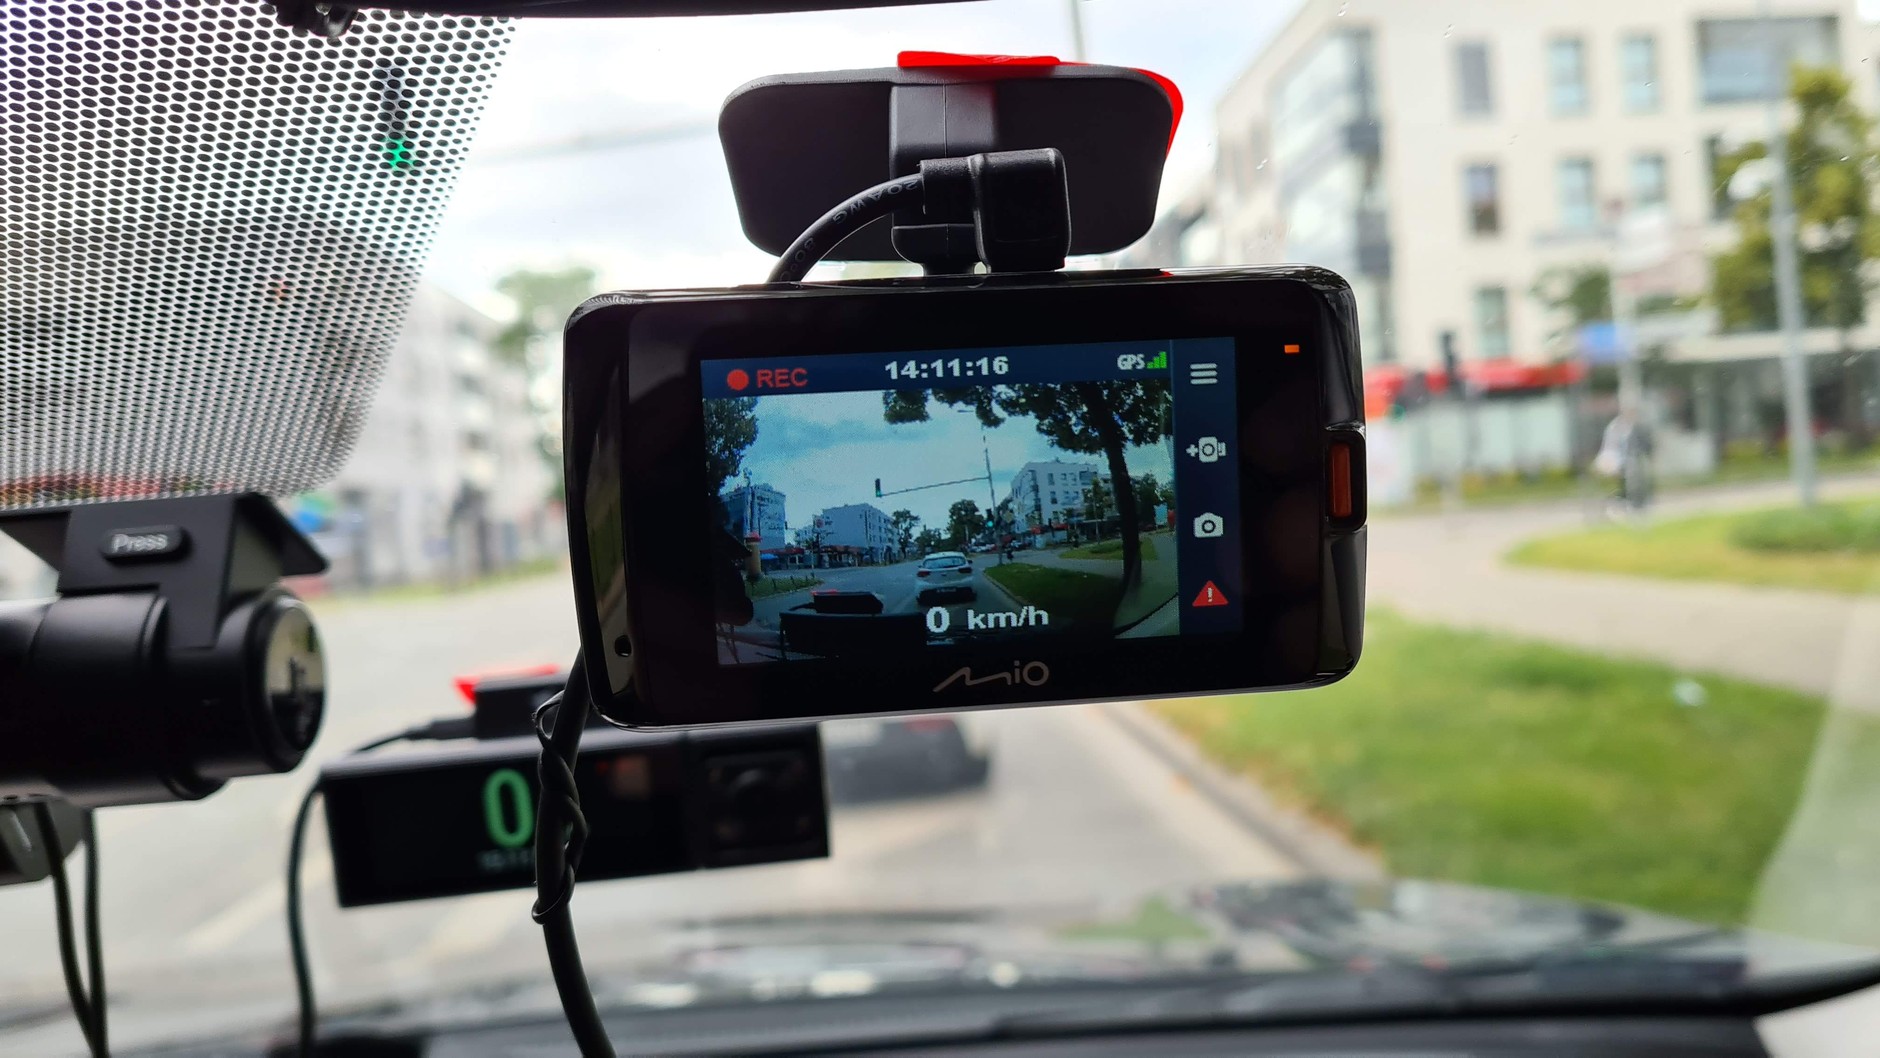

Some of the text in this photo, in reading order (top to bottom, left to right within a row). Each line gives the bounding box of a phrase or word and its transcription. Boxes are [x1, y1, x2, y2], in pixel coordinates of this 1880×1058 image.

[885, 357, 1009, 380] 14:11:16
[1117, 354, 1145, 371] GPS
[757, 368, 808, 388] REC
[110, 532, 168, 552] Press
[927, 606, 1049, 633] 0 km/h
[483, 769, 535, 847] 0
